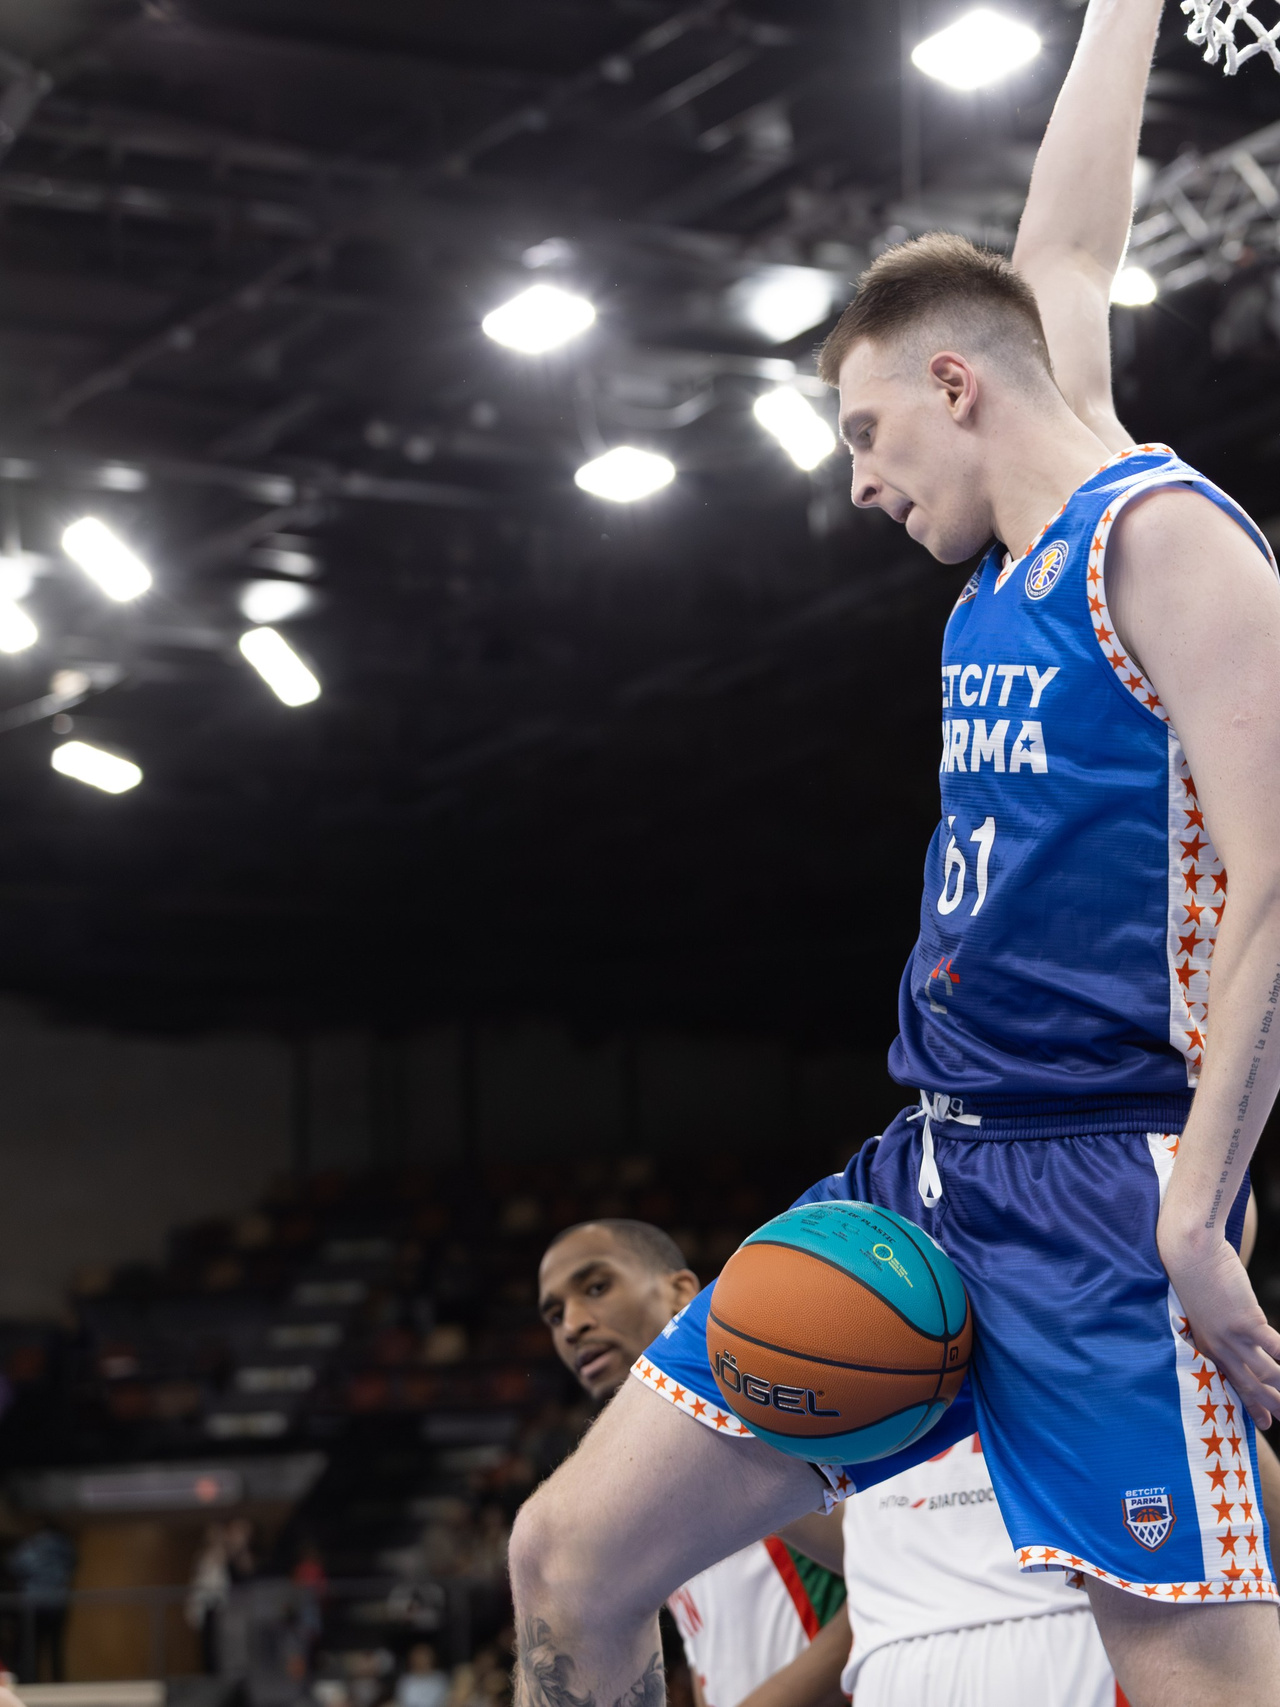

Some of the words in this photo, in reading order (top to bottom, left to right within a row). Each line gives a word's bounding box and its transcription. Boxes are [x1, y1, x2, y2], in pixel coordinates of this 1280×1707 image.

[942, 663, 1060, 708] ETCITY
[940, 719, 1048, 773] ARMA
[937, 815, 996, 917] 61
[861, 1218, 897, 1244] PLASTIC
[1125, 1487, 1166, 1497] BETCITY
[1131, 1497, 1163, 1506] PARMA
